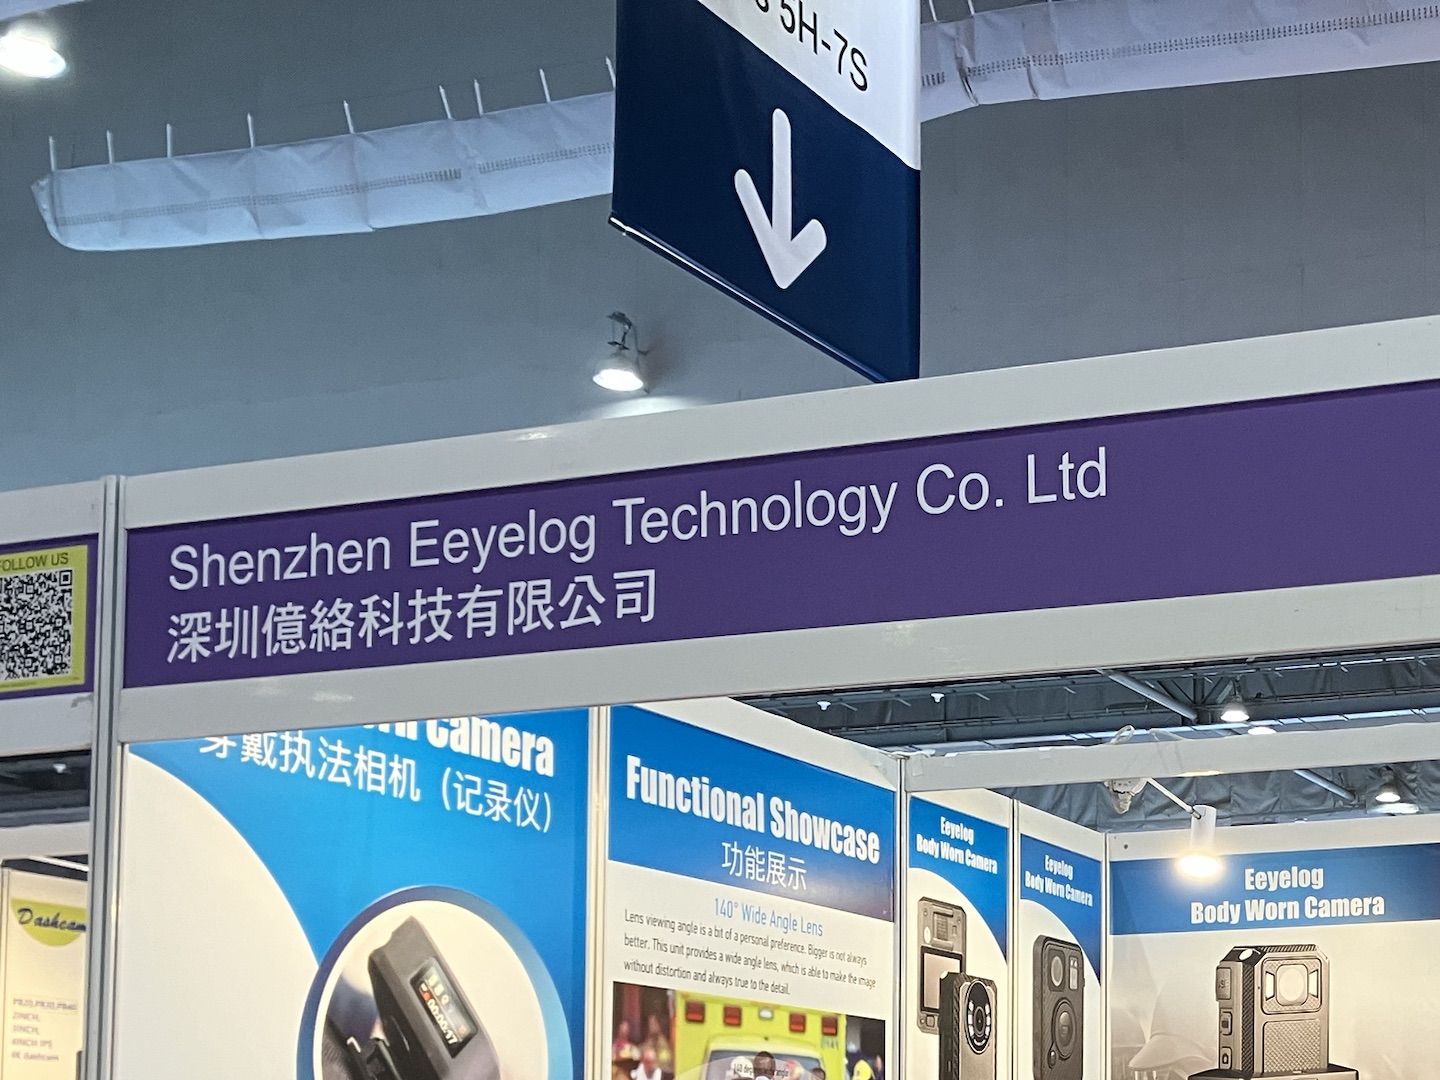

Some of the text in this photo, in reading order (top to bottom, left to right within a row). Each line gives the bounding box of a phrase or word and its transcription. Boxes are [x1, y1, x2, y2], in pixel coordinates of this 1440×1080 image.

[780, 0, 868, 91] 5H-7S
[168, 446, 1108, 592] Shenzhen Eeyelog Technology Co. Ltd
[51, 552, 69, 566] US
[166, 568, 657, 665] 深圳億絡科技有限公司
[425, 717, 555, 778] Camera
[626, 754, 880, 864] Functional Showcase
[940, 816, 974, 845] Eeyelog
[721, 841, 808, 891] 功能展示
[916, 834, 998, 875] Body Worn Camera
[1045, 855, 1073, 881] Eeyelog
[1025, 871, 1093, 907] Body Worn Camera
[1244, 866, 1324, 892] Eeyelog
[714, 898, 823, 937] 140° Wide Angle Lens
[1190, 895, 1385, 925] Body Worn Camera
